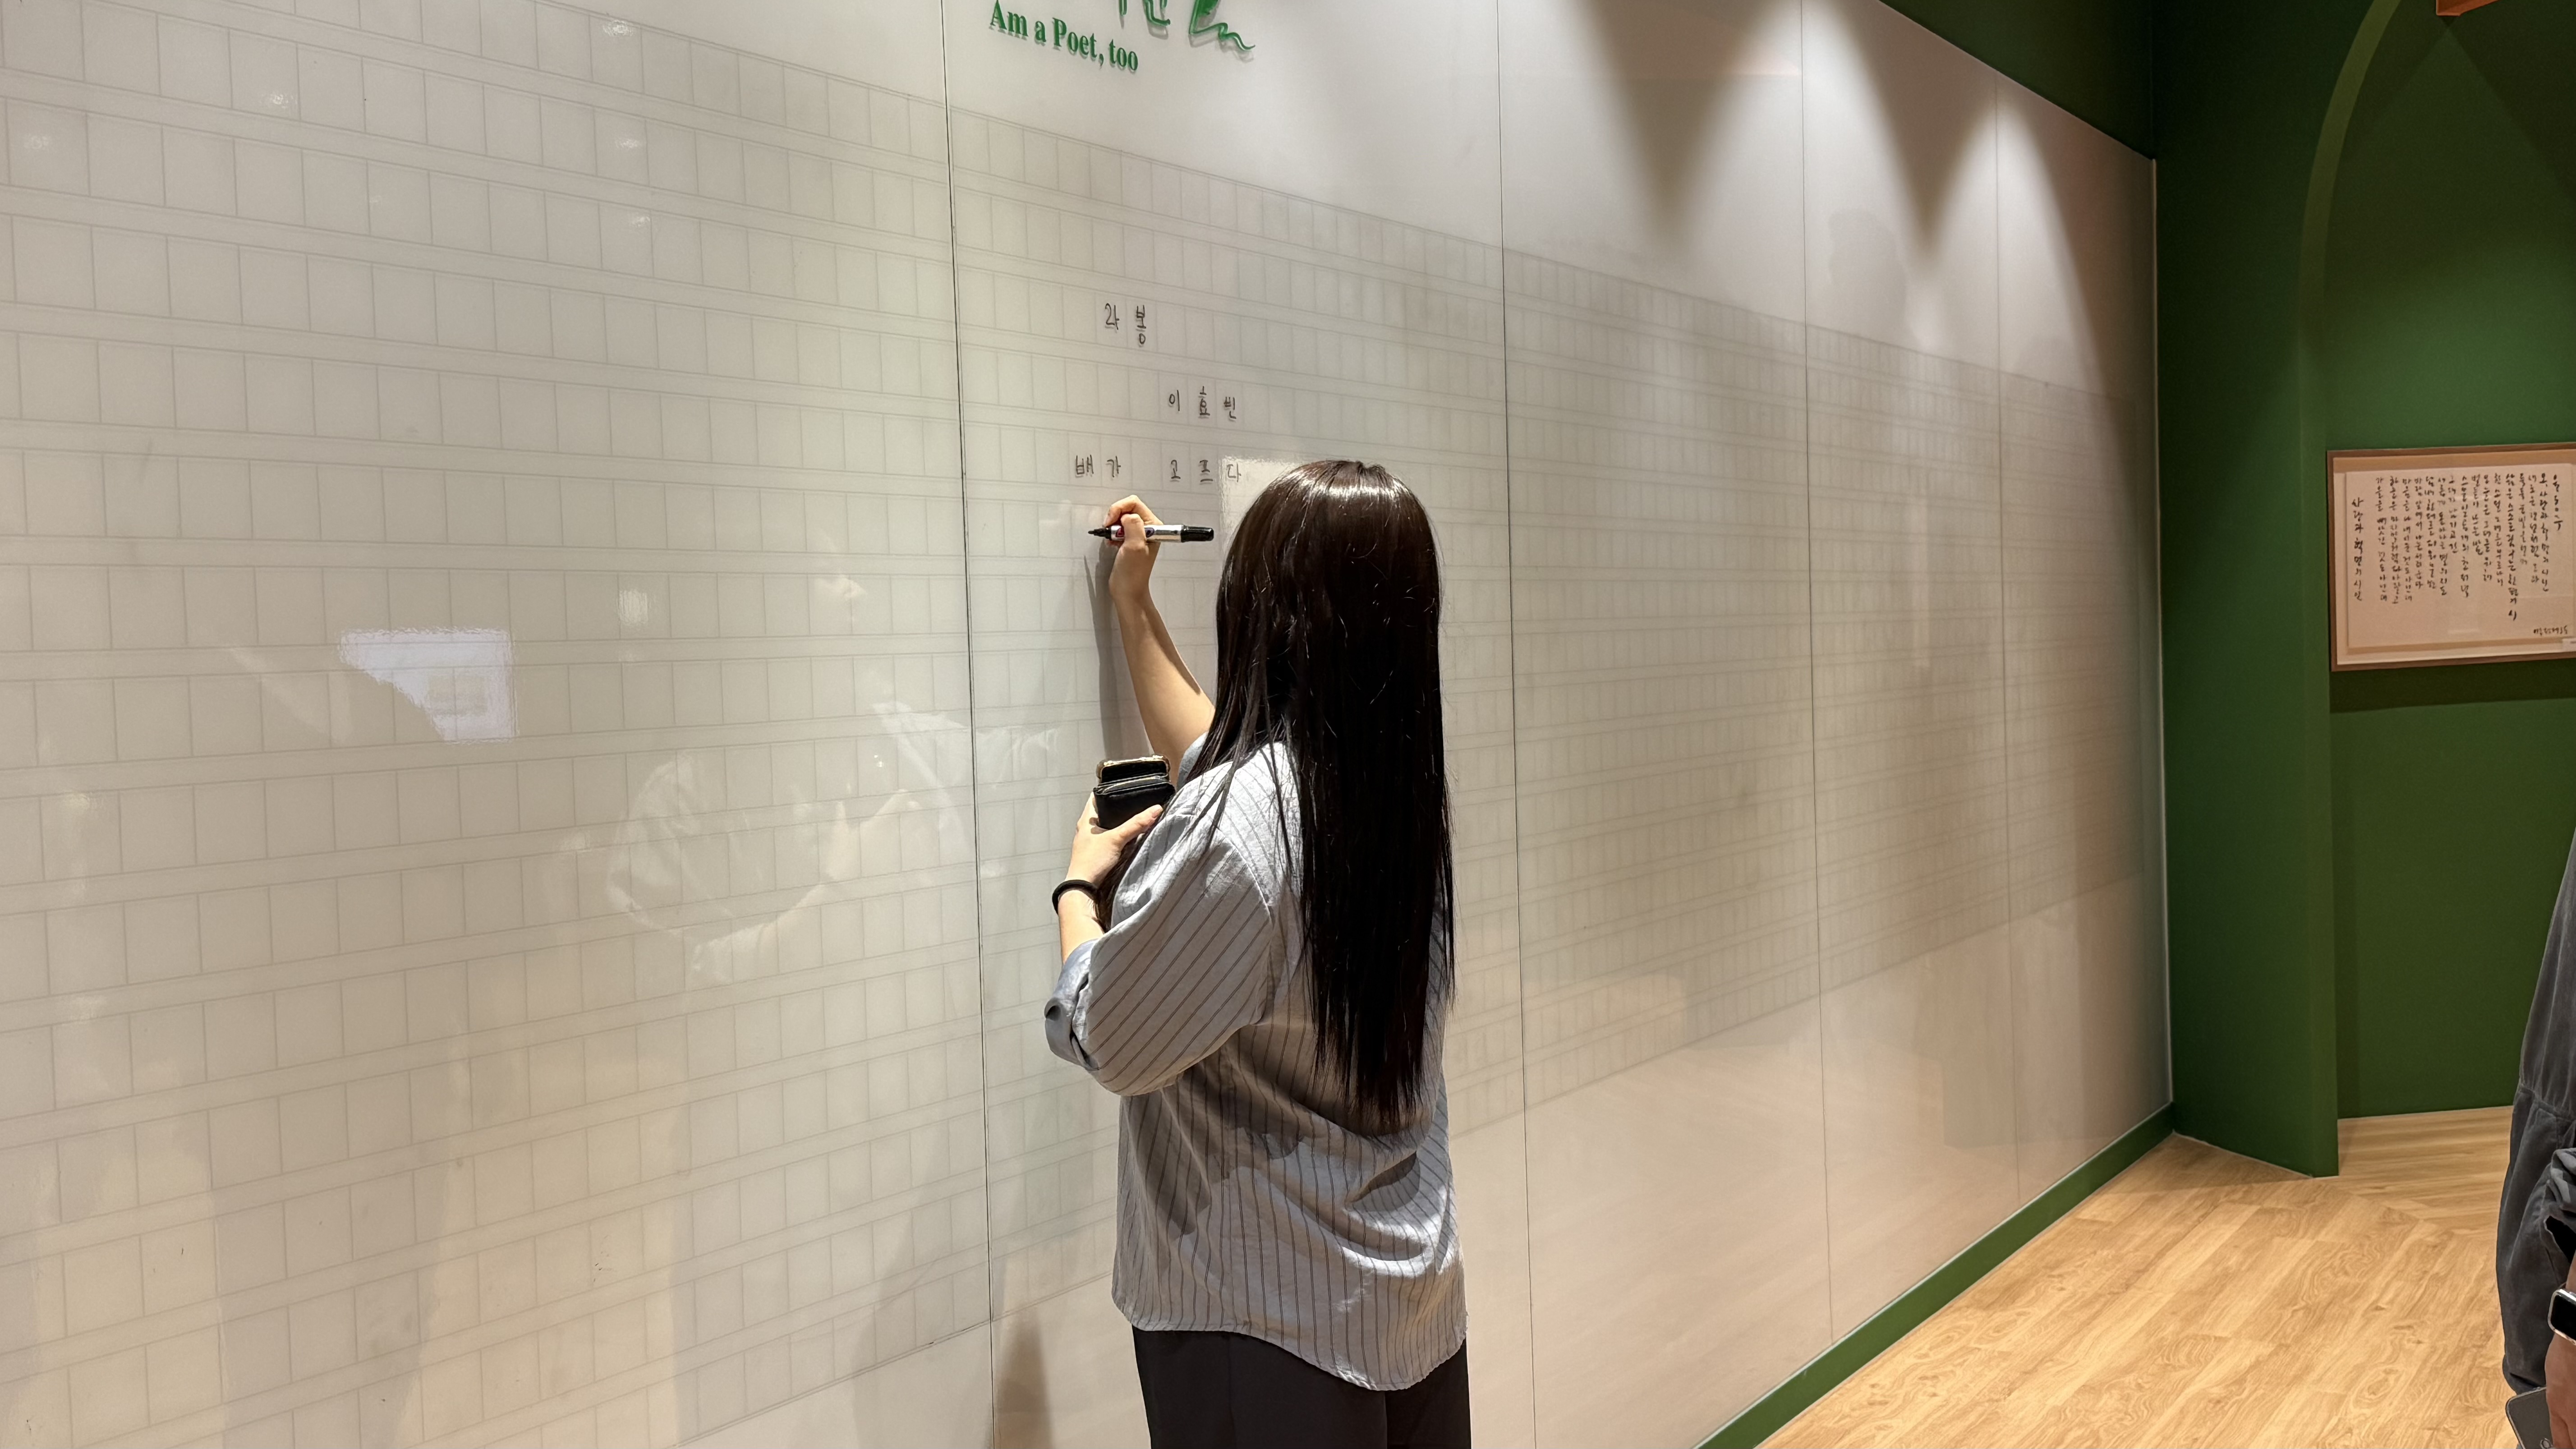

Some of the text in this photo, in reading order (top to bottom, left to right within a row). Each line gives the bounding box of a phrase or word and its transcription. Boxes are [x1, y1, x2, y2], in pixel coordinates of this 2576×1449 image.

[990, 3, 1028, 37] Am
[1035, 21, 1046, 42] a
[1052, 18, 1104, 66] Poet,
[1109, 39, 1138, 71] too
[1076, 455, 1241, 482] 배가 고프다
[2352, 497, 2364, 601] 사랑과 혁명의 시인
[2508, 610, 2517, 621] 시
